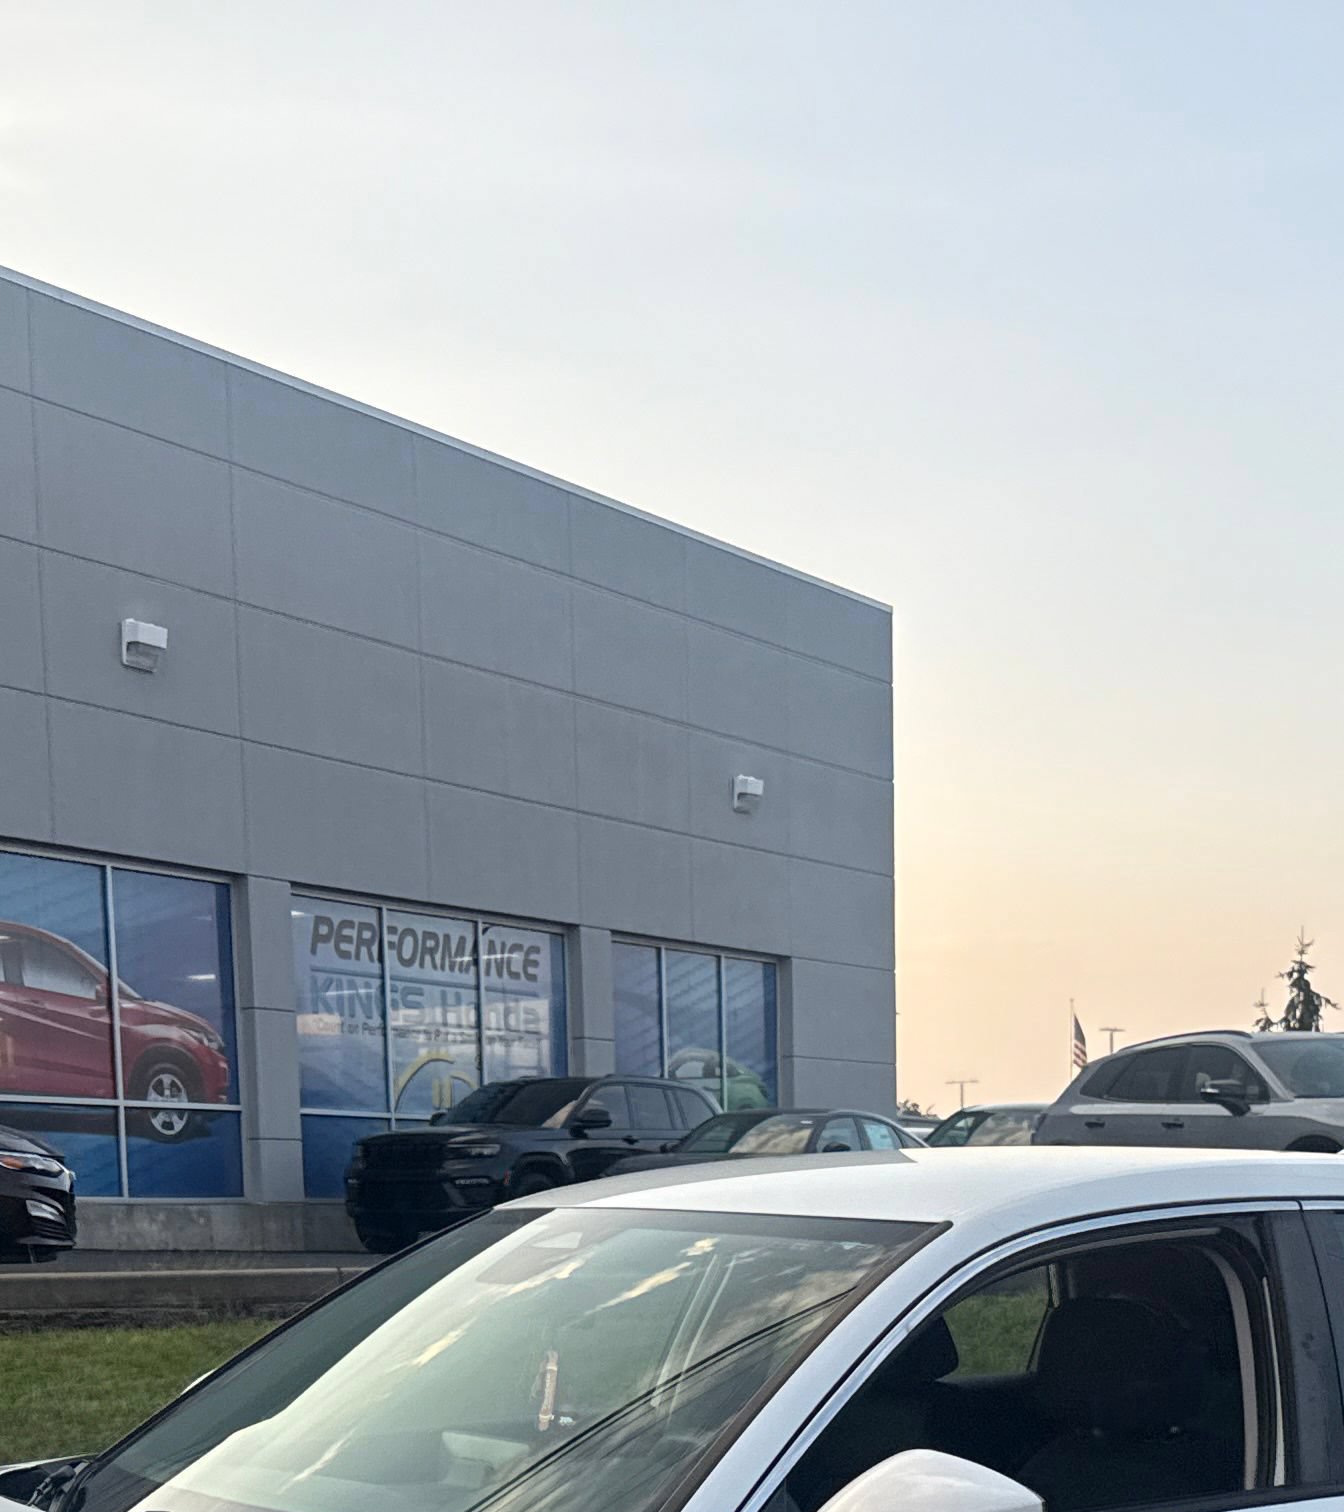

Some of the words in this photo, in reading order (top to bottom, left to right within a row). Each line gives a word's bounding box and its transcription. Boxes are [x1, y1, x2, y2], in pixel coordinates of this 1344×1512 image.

[309, 914, 542, 984] PERFORMANCE
[309, 974, 425, 1026] KINGS
[440, 988, 542, 1034] Honda
